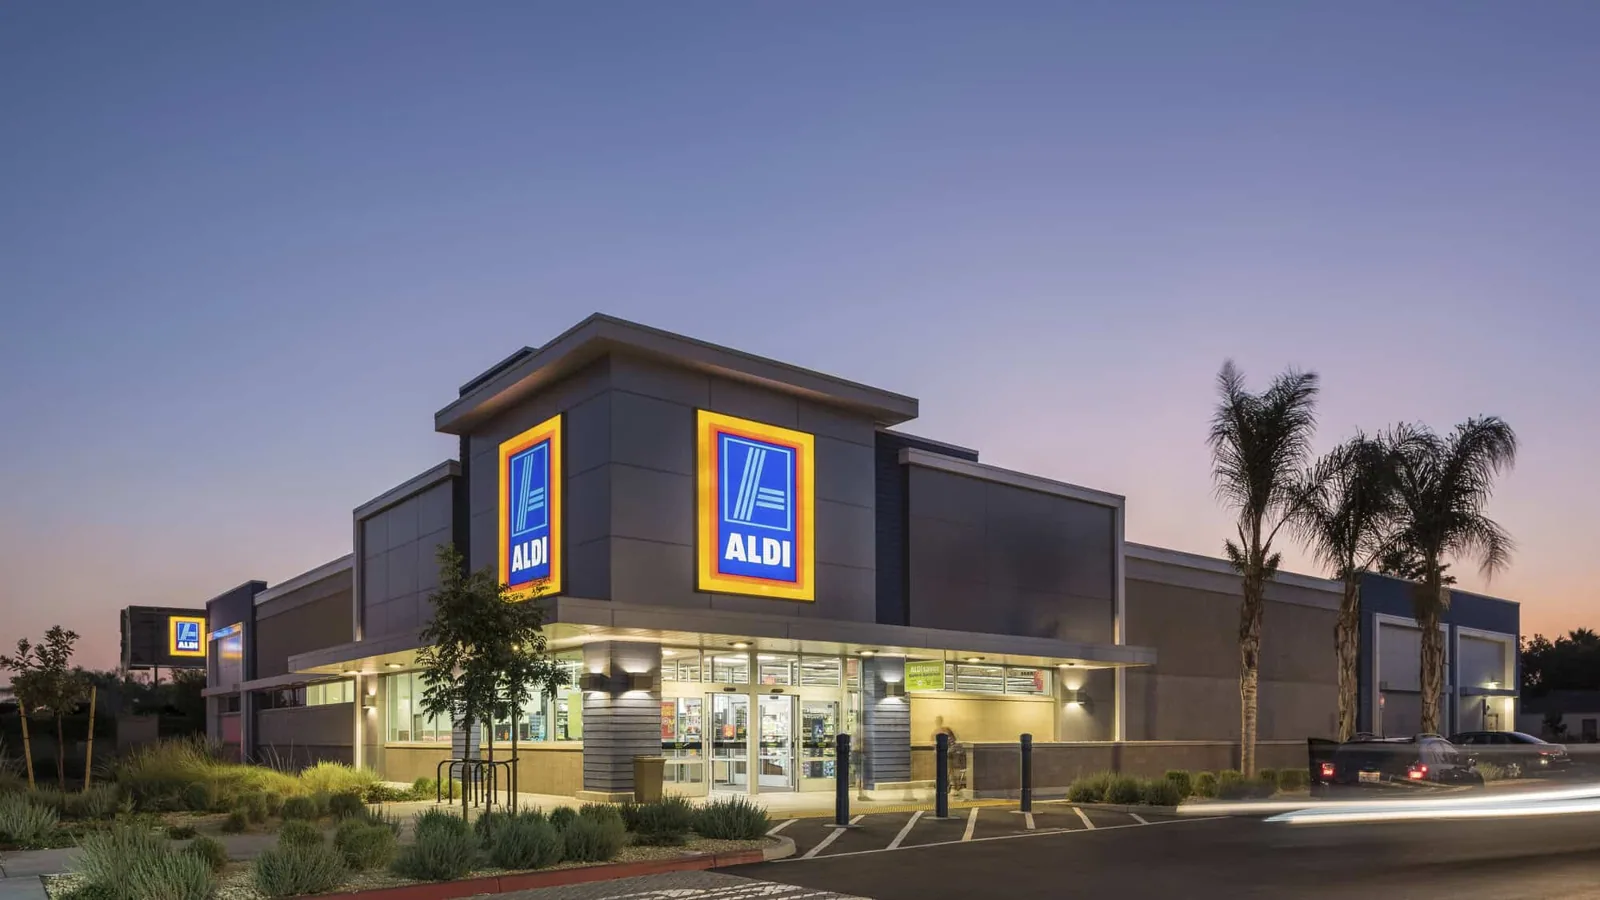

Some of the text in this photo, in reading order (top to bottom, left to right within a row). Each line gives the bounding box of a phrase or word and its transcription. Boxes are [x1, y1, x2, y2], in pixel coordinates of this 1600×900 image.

[512, 536, 547, 573] ALDI
[724, 532, 791, 567] ALDI
[178, 641, 198, 649] ALDI
